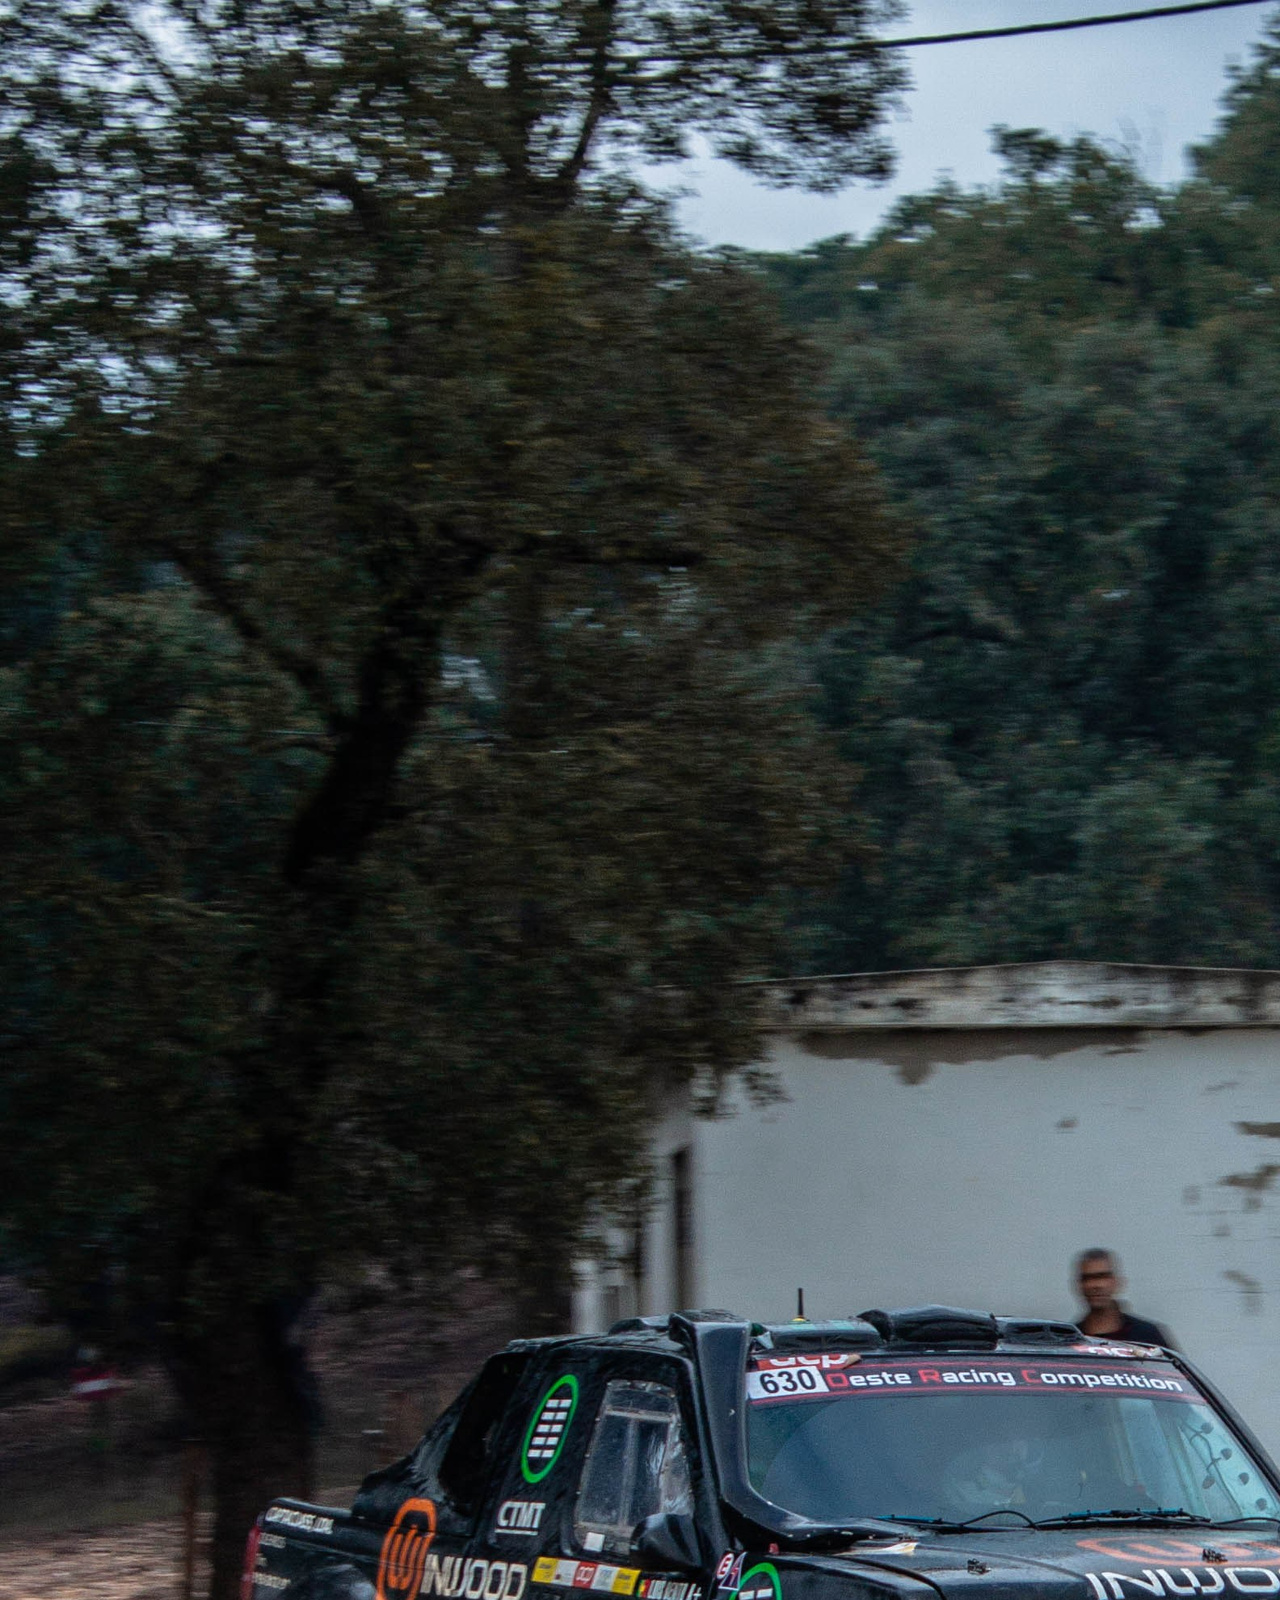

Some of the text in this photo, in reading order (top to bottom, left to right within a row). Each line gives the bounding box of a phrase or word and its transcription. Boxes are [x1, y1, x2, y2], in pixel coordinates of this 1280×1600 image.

[759, 1369, 818, 1394] 630
[826, 1369, 1184, 1392] Oeste Racing Competition
[497, 1501, 546, 1529] CTMT
